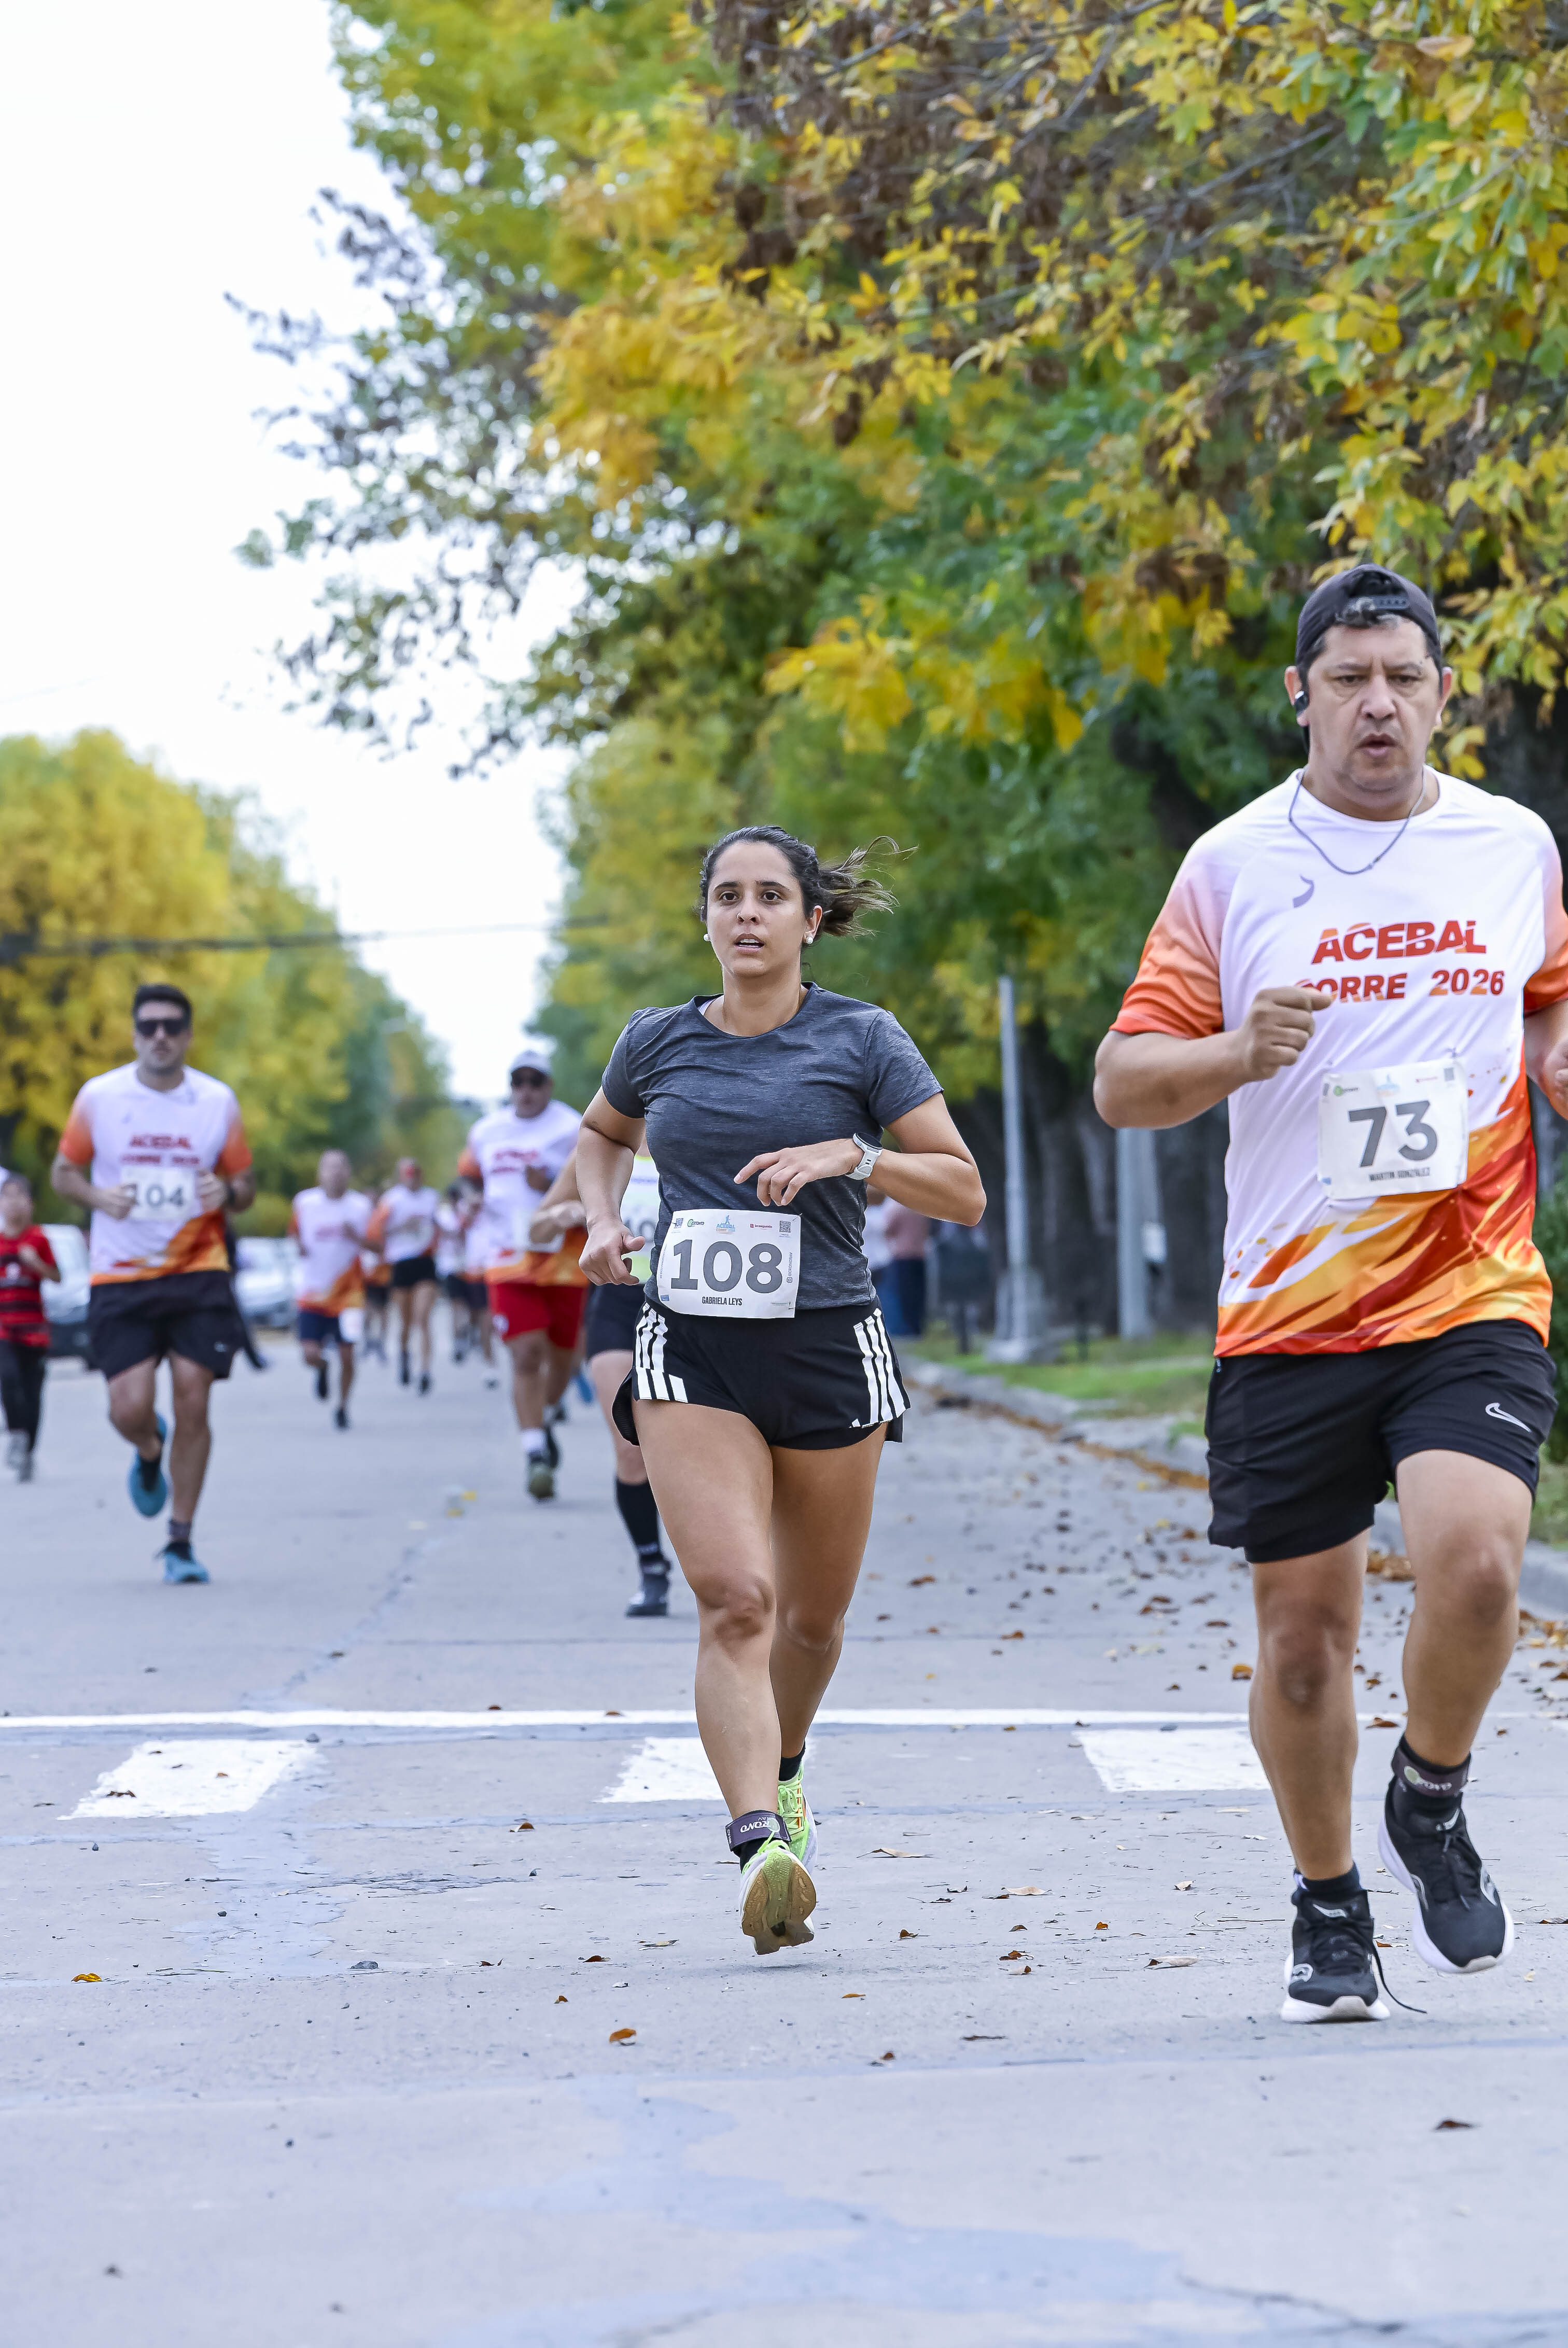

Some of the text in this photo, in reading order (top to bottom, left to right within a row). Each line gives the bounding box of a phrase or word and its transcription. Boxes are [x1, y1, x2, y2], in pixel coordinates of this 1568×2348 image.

[1311, 920, 1486, 964] ACEBAL
[1430, 969, 1504, 996] 2026
[1348, 1100, 1437, 1167] 73
[671, 1239, 782, 1293] 108
[702, 1296, 727, 1305] GABRIELA
